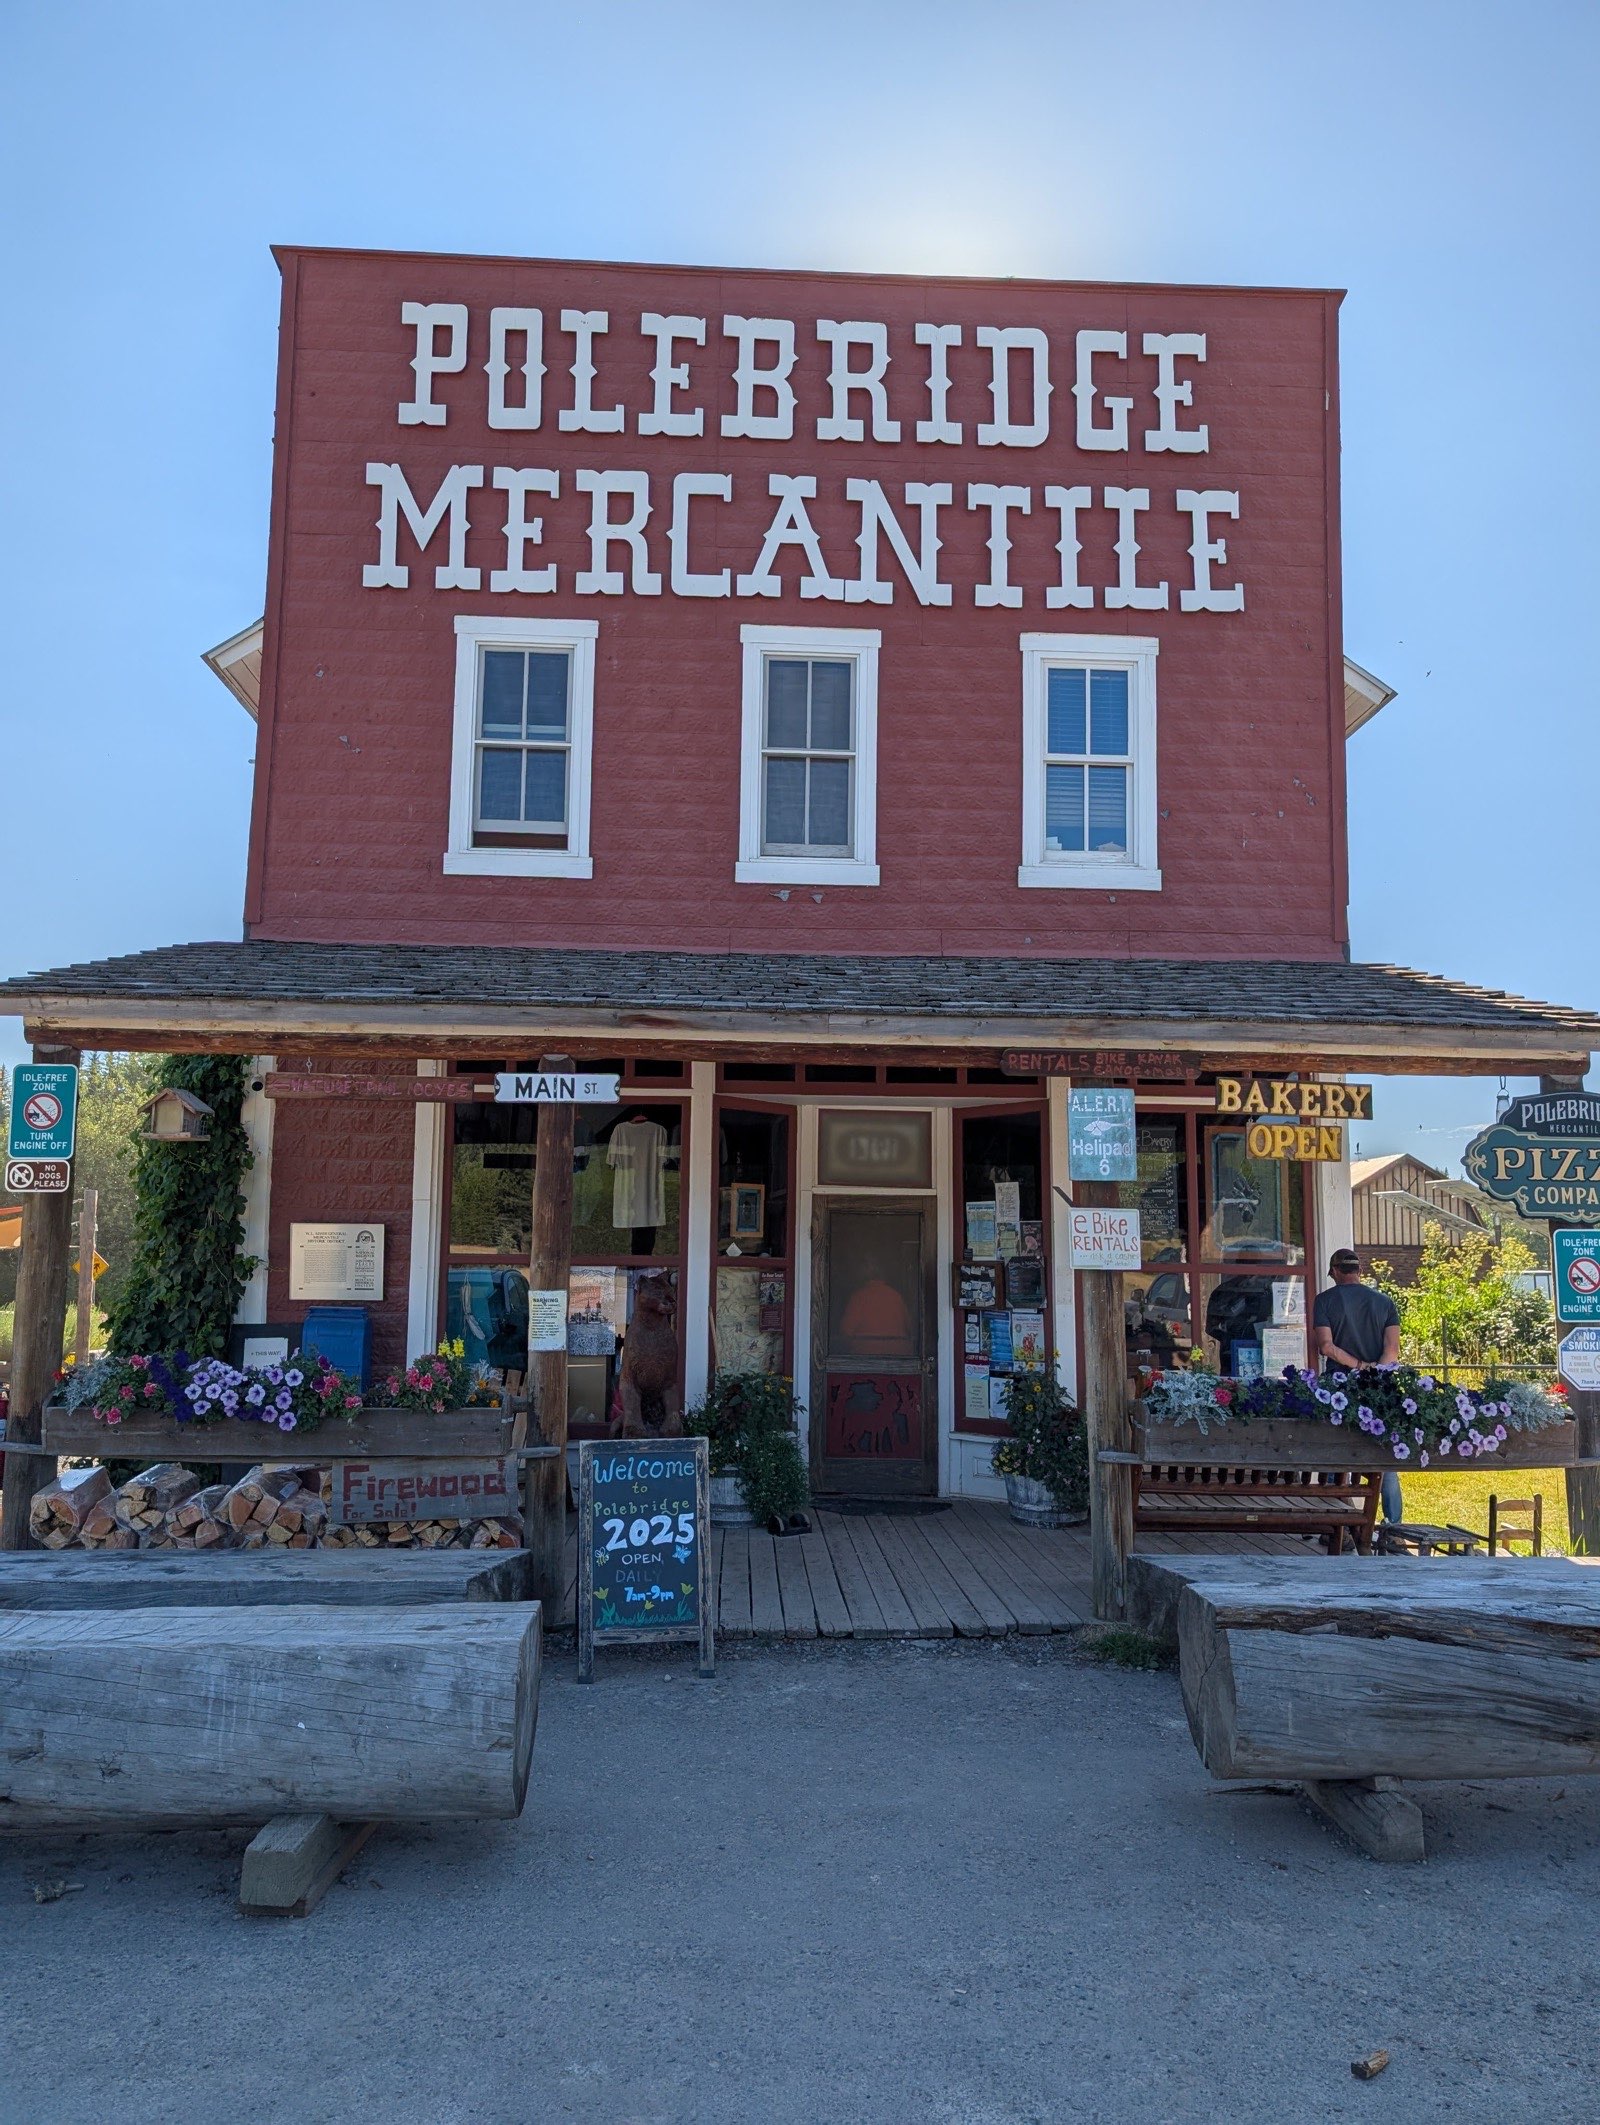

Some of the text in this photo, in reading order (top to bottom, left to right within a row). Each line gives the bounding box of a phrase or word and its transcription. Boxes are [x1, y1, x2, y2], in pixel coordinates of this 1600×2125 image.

[398, 301, 1209, 454] POLEBRIDGE
[362, 462, 1245, 612] MERCANTILE
[1007, 1052, 1183, 1072] RENTALS BIKE KAYAK
[22, 1073, 68, 1082] IDLE-FREE
[32, 1083, 57, 1091] ZONE
[515, 1077, 599, 1099] MAIN ST.
[1071, 1095, 1132, 1112] A.L.E.R.T.
[1217, 1079, 1371, 1119] BAKERY
[30, 1132, 54, 1141] TURN
[1250, 1124, 1341, 1160] OPEN
[14, 1141, 68, 1150] ENGINE OFF
[1072, 1139, 1133, 1159] Helipad
[44, 1164, 57, 1172] NO
[1099, 1158, 1111, 1176] 6
[33, 1180, 66, 1188] PLEASE
[1073, 1235, 1139, 1252] RENTALS
[1573, 1247, 1595, 1256] ZONE
[1575, 1295, 1598, 1304] TURN
[1562, 1304, 1593, 1313] ENGINE
[1583, 1331, 1597, 1341] NO
[593, 1456, 696, 1484] Welcome
[343, 1459, 507, 1501] Firewood
[632, 1482, 648, 1494] to
[372, 1502, 417, 1519] Sale!
[593, 1498, 690, 1518] Polebridge
[602, 1512, 695, 1552] 2025
[621, 1552, 662, 1565] OPEN
[615, 1569, 663, 1583] DAILY
[624, 1585, 675, 1603] 7am-9pm
